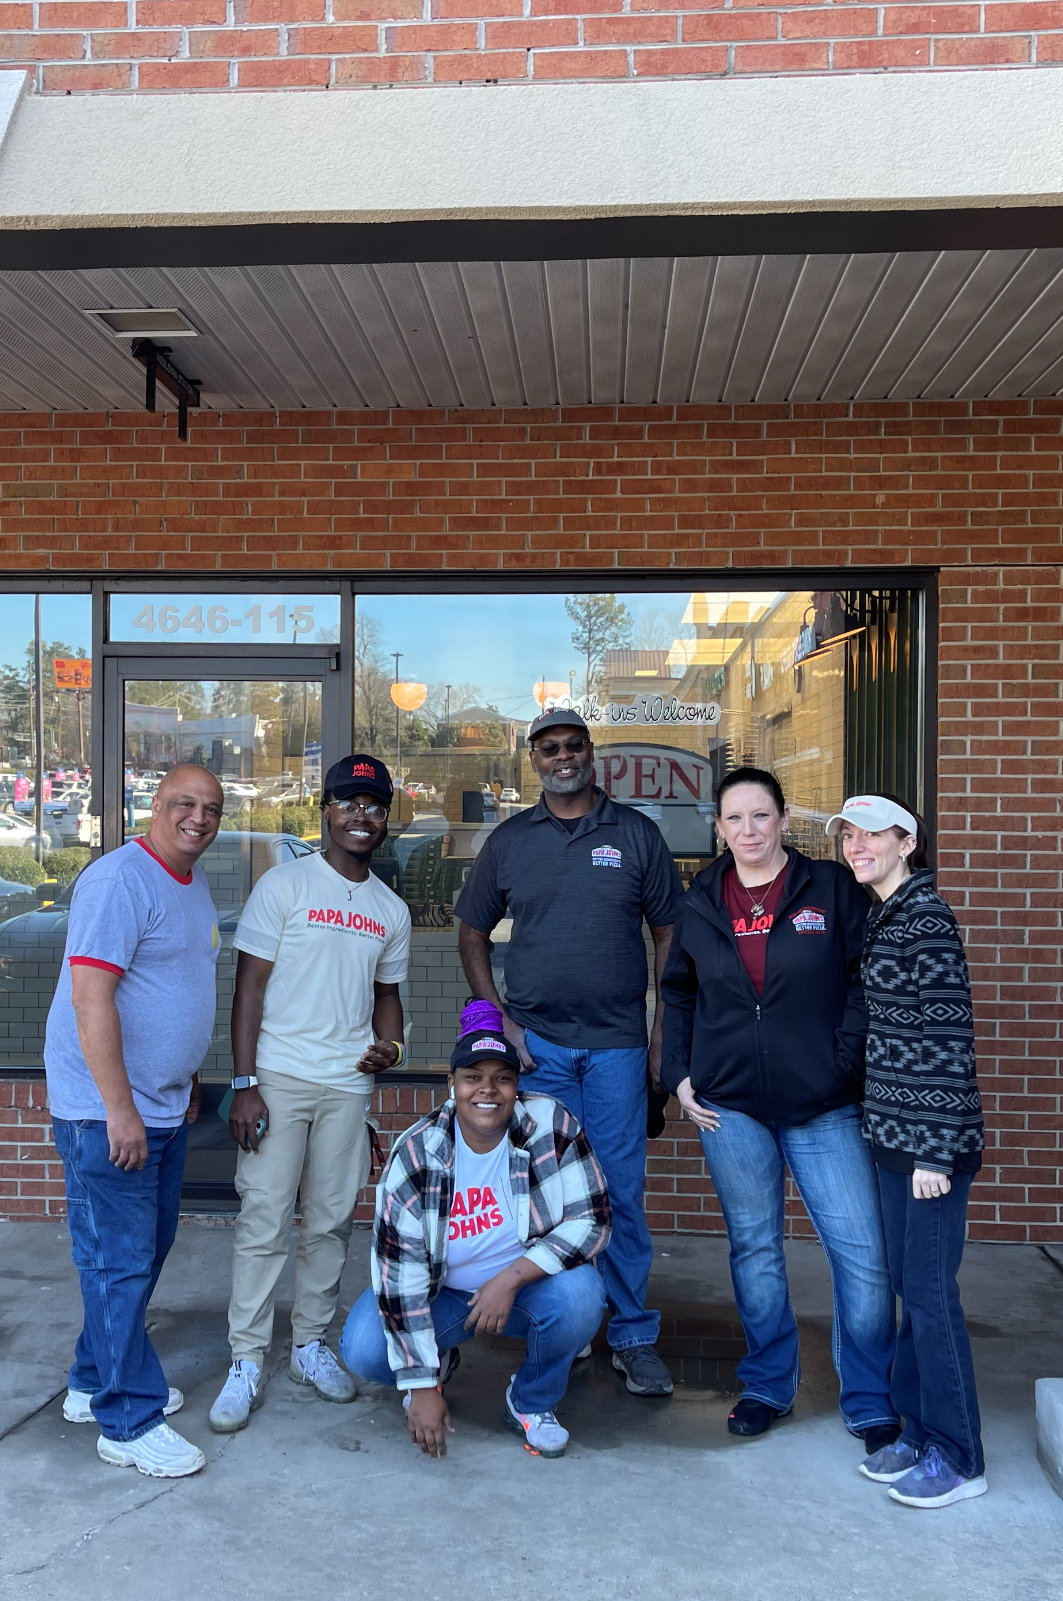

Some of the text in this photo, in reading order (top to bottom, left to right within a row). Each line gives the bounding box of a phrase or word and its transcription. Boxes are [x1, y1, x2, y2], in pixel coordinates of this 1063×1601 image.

[133, 605, 314, 633] 4646-115
[642, 697, 716, 722] Welcome
[353, 762, 375, 772] PAPA
[591, 754, 704, 800] PEN
[308, 908, 386, 938] PAPA JOHNS
[473, 1041, 486, 1050] PAPA
[450, 1187, 498, 1218] APA
[448, 1207, 504, 1241] OHNS
